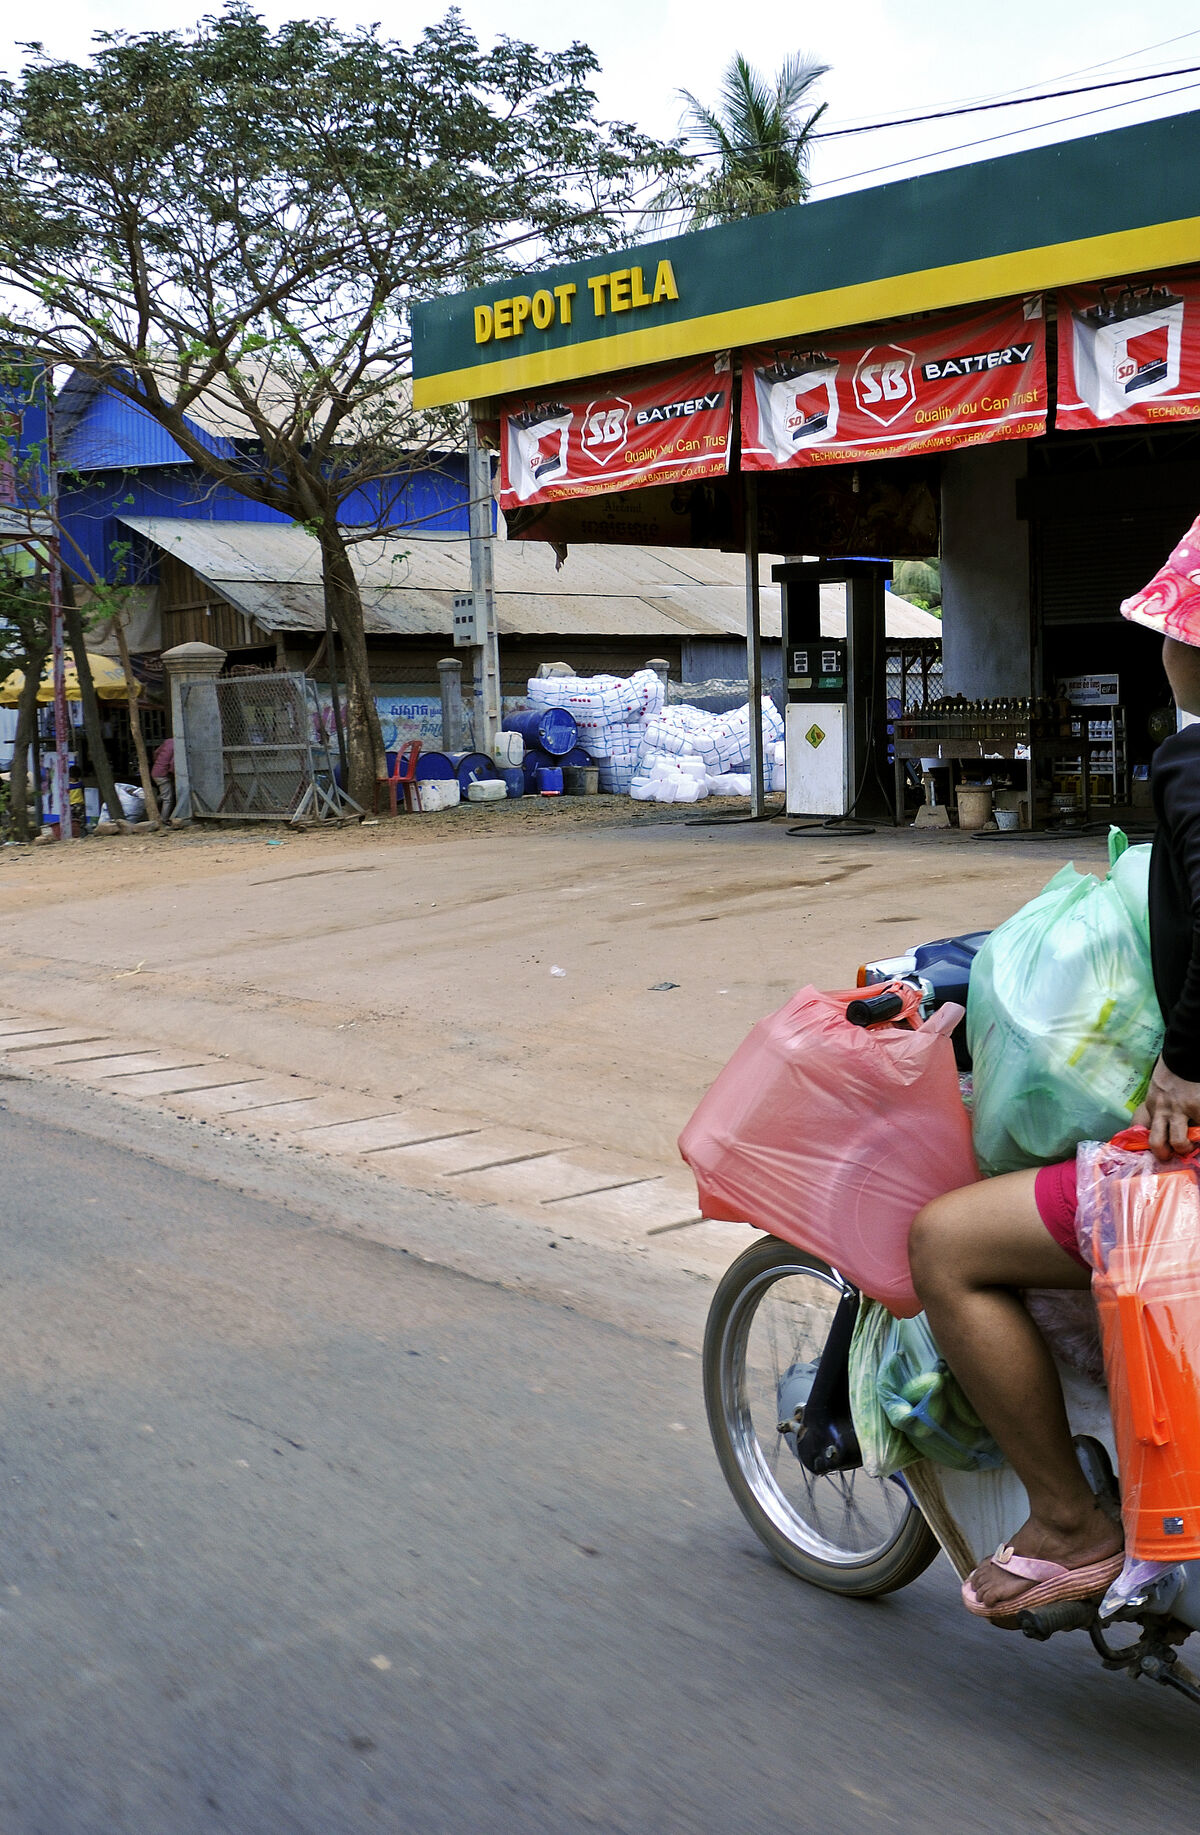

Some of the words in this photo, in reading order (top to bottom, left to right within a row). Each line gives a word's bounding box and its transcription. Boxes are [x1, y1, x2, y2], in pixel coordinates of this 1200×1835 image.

[474, 283, 576, 344] DEPOT
[588, 259, 679, 316] TELA
[925, 345, 1032, 380] BATTERY
[1118, 364, 1135, 379] SB
[861, 360, 907, 404] SB
[636, 393, 720, 425] BATTERY
[915, 404, 956, 424] Quality
[981, 396, 1009, 412] Can
[1012, 389, 1039, 405] Trust
[587, 408, 625, 446] SB
[625, 447, 658, 464] Quality
[676, 439, 700, 452] Can
[703, 435, 728, 447] Trus
[810, 449, 861, 462] TECHNOLOGY
[864, 446, 888, 457] FROM
[945, 432, 986, 445] BATTERY
[647, 470, 680, 482] BATTERY
